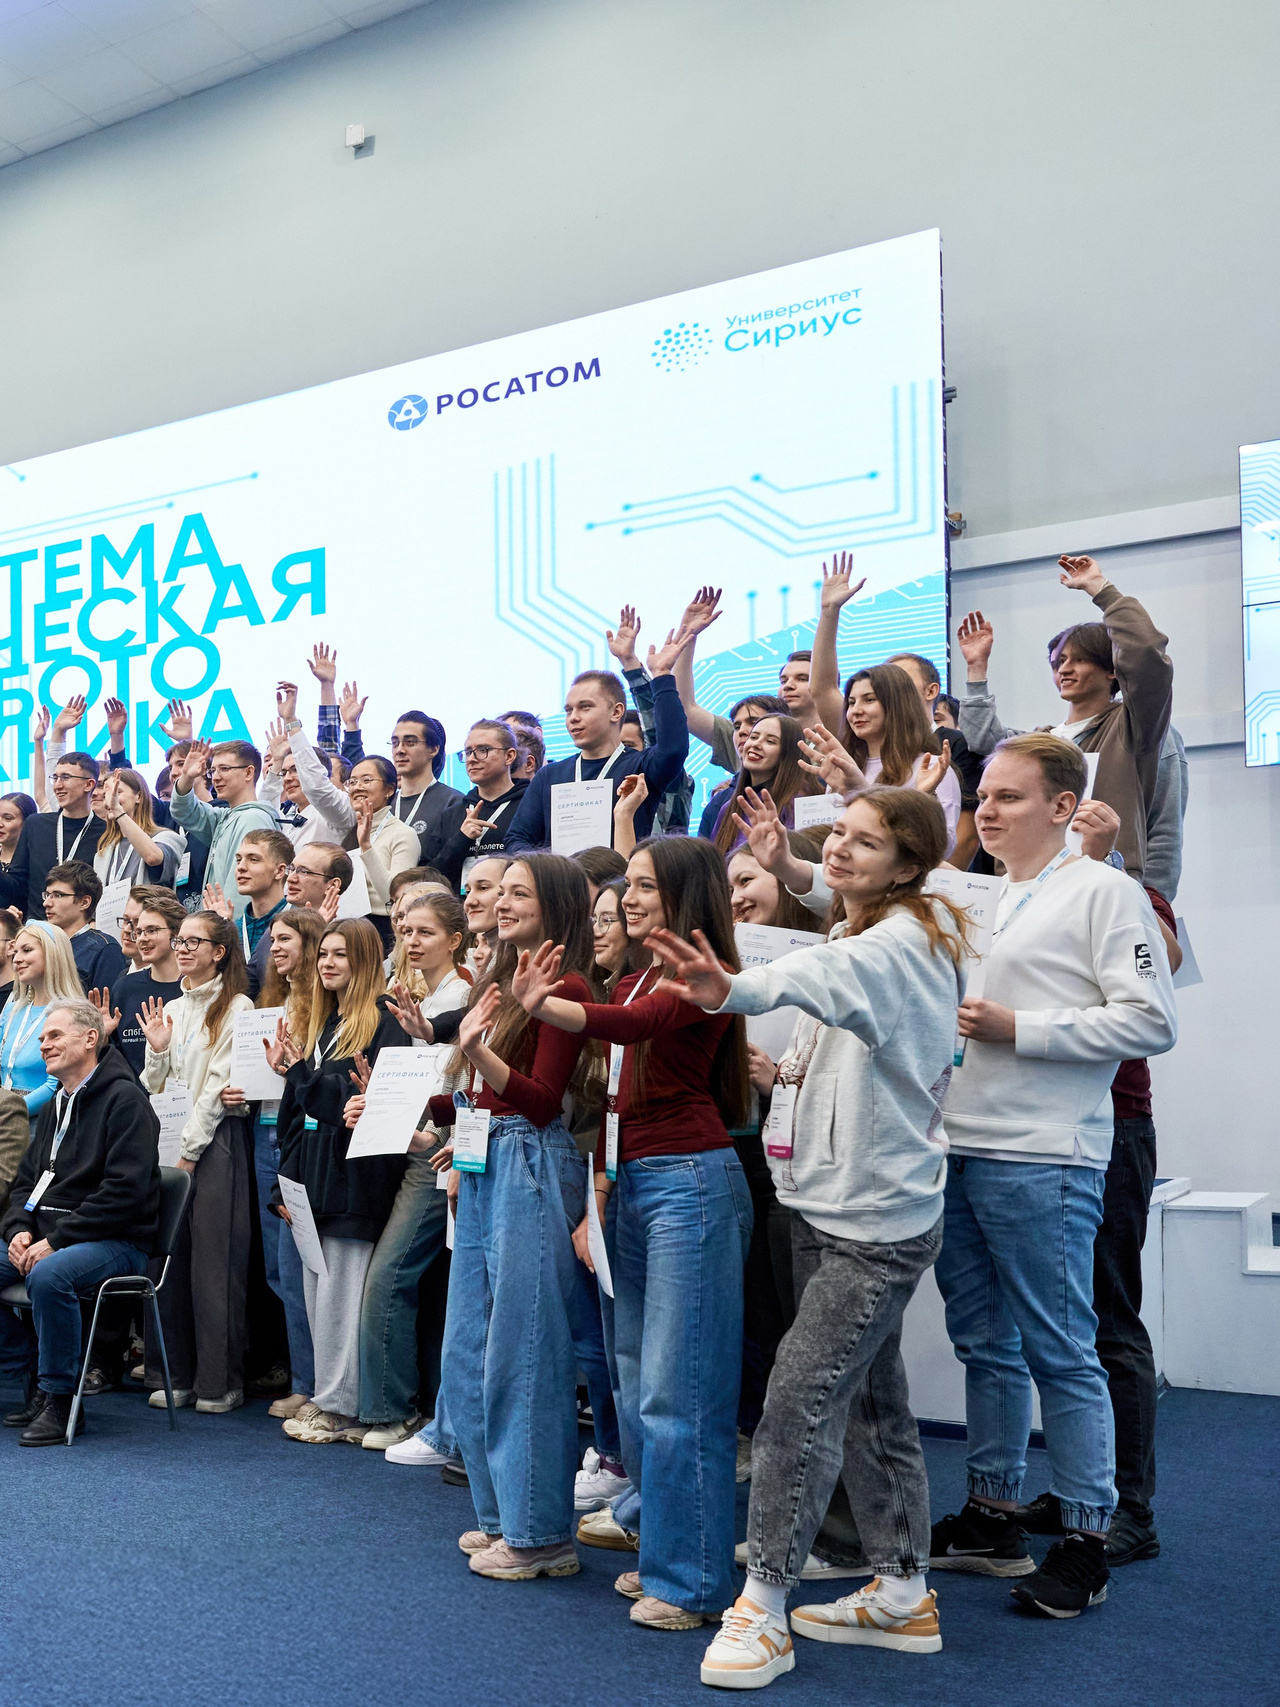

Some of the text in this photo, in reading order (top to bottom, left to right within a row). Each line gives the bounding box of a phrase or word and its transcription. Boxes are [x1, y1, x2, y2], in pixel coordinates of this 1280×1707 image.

[726, 288, 862, 329] Университет
[724, 308, 862, 352] Сириус
[436, 357, 602, 415] РОСАТОМ
[558, 800, 603, 810] СЕРТИФИКАТ
[802, 816, 839, 825] СЕРТИФИ
[237, 1029, 276, 1038] СЕРТИФИКАТ
[377, 1071, 430, 1079] СЕРТИФИКАТ
[969, 1502, 1008, 1521] FILA
